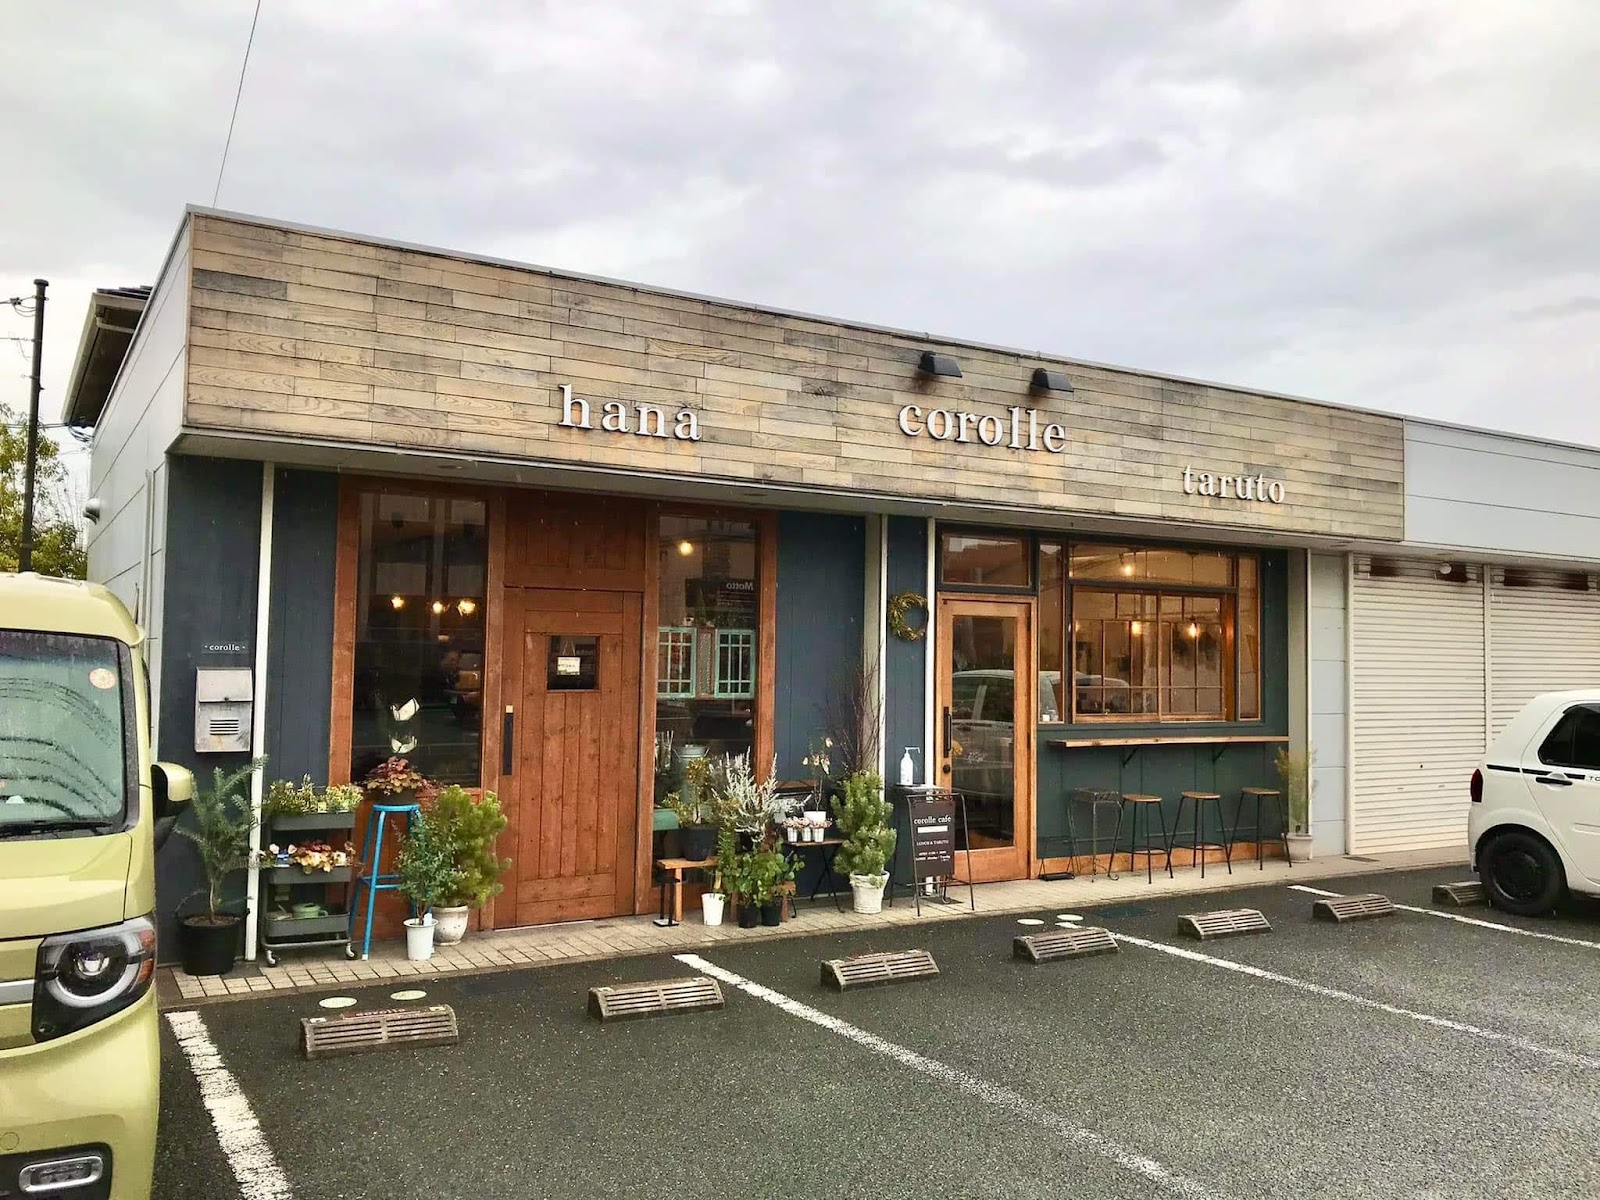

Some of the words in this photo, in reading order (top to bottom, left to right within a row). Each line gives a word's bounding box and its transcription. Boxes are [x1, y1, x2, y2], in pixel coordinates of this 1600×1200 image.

[558, 383, 702, 441] hana
[899, 404, 1067, 453] corolle
[1182, 464, 1286, 504] taruto
[209, 643, 240, 651] corolle
[914, 816, 936, 824] corolle
